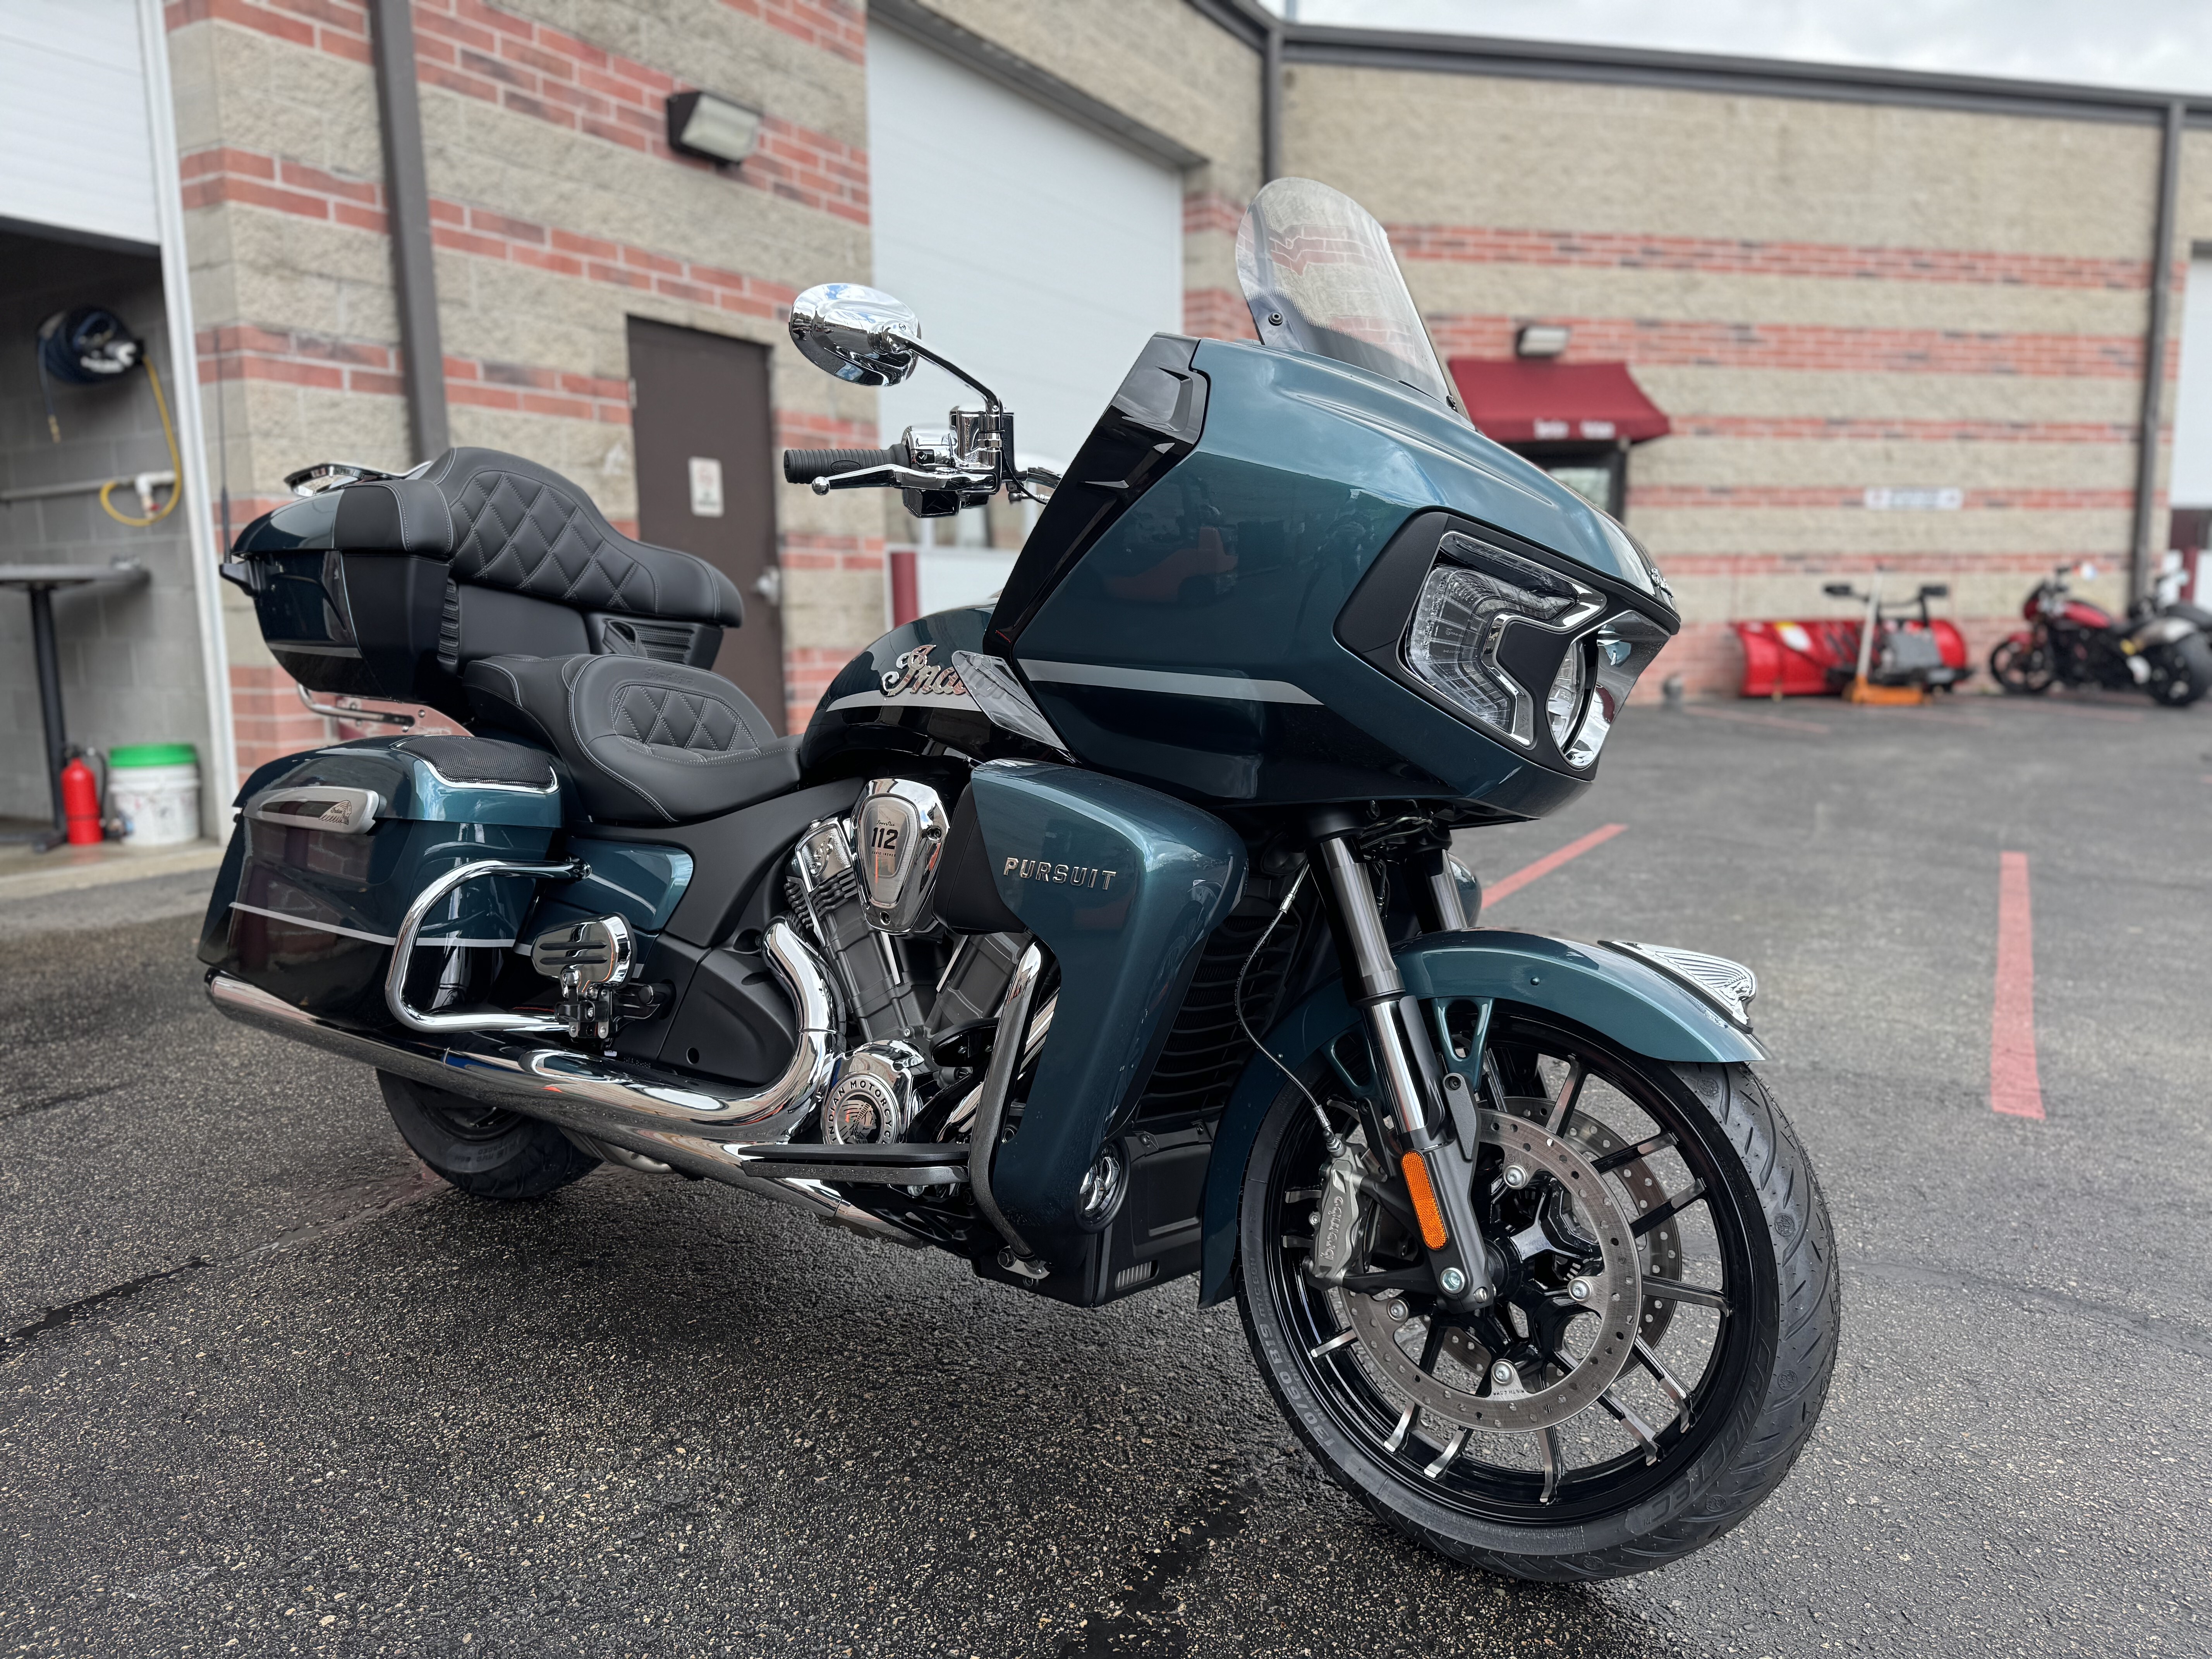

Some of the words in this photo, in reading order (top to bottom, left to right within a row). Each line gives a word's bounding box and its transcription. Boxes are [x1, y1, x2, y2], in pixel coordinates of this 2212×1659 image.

[644, 666, 694, 687] Indian
[871, 827, 898, 850] 112
[1003, 857, 1116, 890] PURSUIT
[828, 1087, 845, 1142] INDIAN
[850, 1080, 892, 1144] MOTORCYC
[1320, 1196, 1343, 1261] brembo
[1255, 1287, 1267, 1318] M/C
[1259, 1324, 1283, 1365] B19
[1274, 1335, 1328, 1422] REINFORCED
[1278, 1370, 1336, 1448] 130/60
[1652, 1338, 1771, 1522] CRUISETEC
